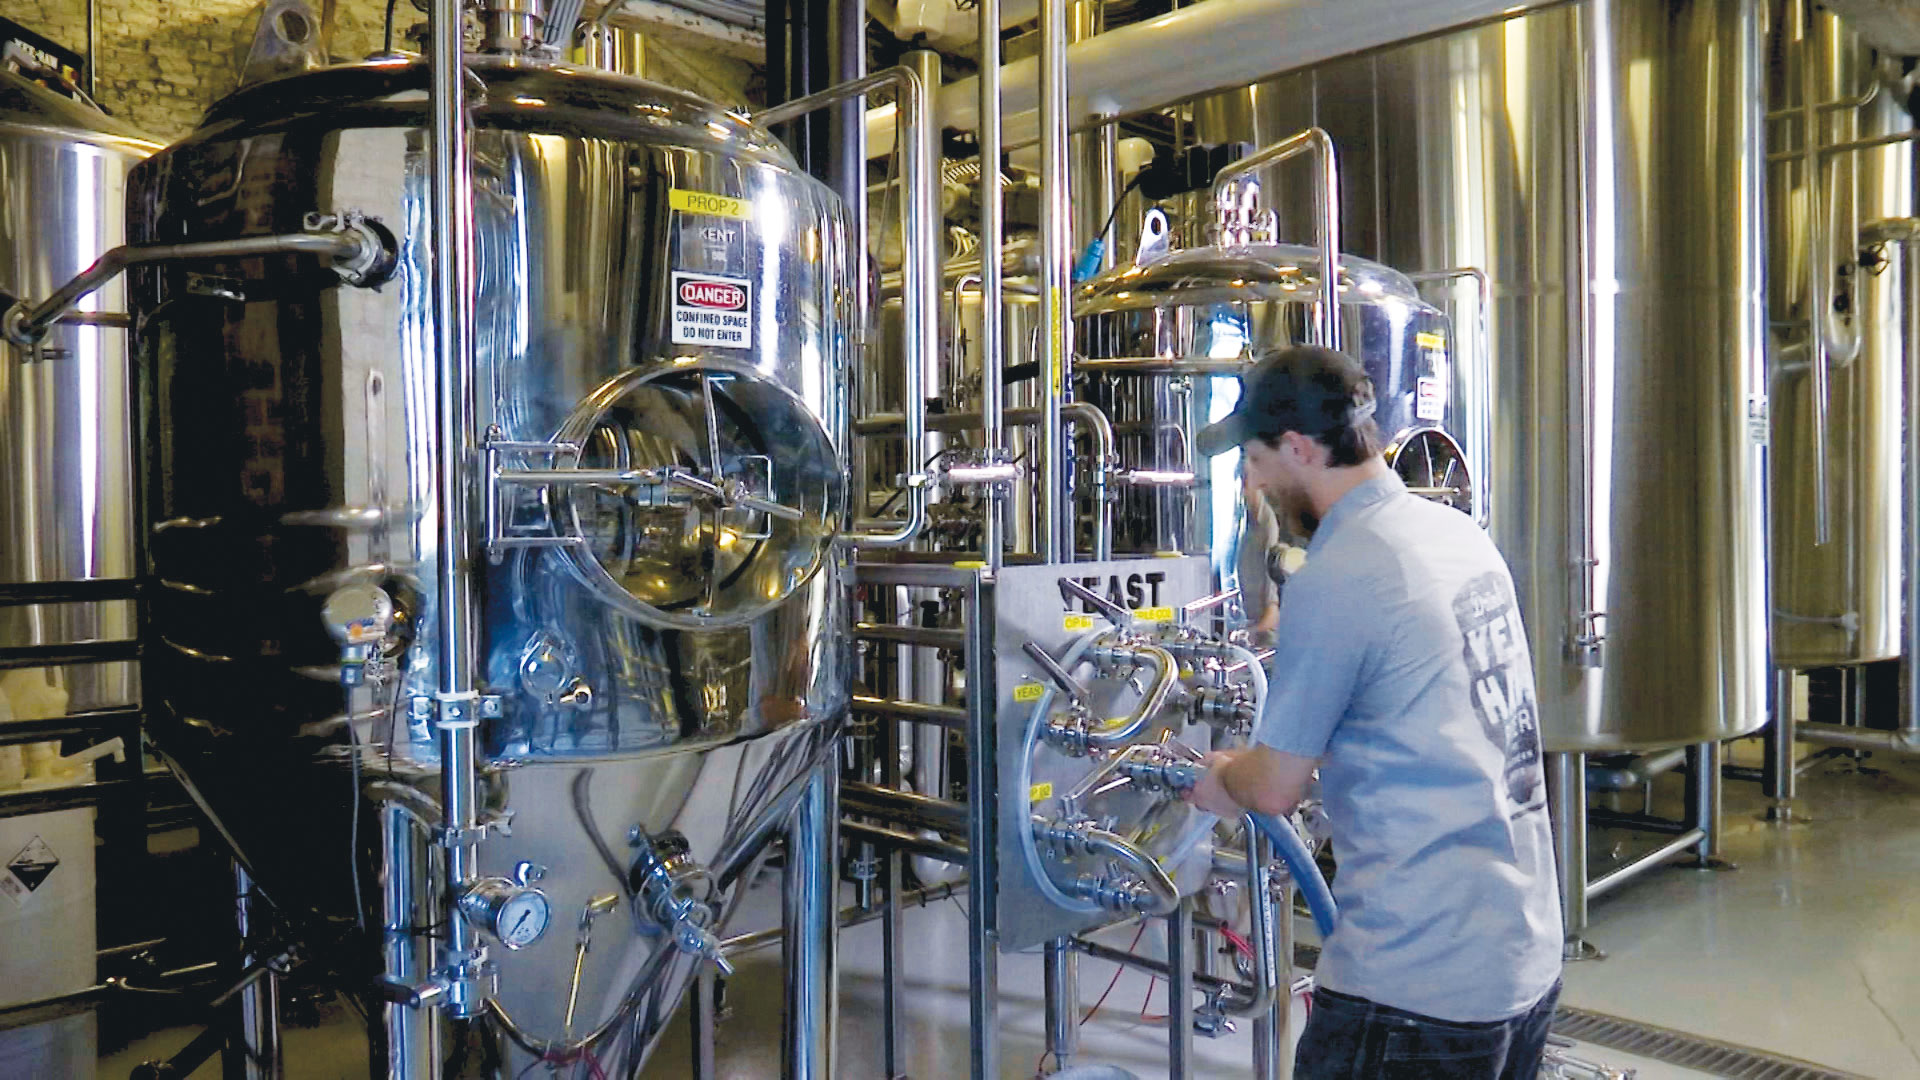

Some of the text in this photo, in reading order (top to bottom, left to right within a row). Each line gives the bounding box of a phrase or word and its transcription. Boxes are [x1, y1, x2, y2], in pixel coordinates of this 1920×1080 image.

[687, 195, 739, 216] PROP 2
[698, 227, 736, 244] KENT
[685, 284, 741, 305] DANGER
[676, 310, 748, 328] CONFINED SPACE
[683, 326, 742, 342] DO NOT ENTER
[1016, 686, 1041, 698] YEAS
